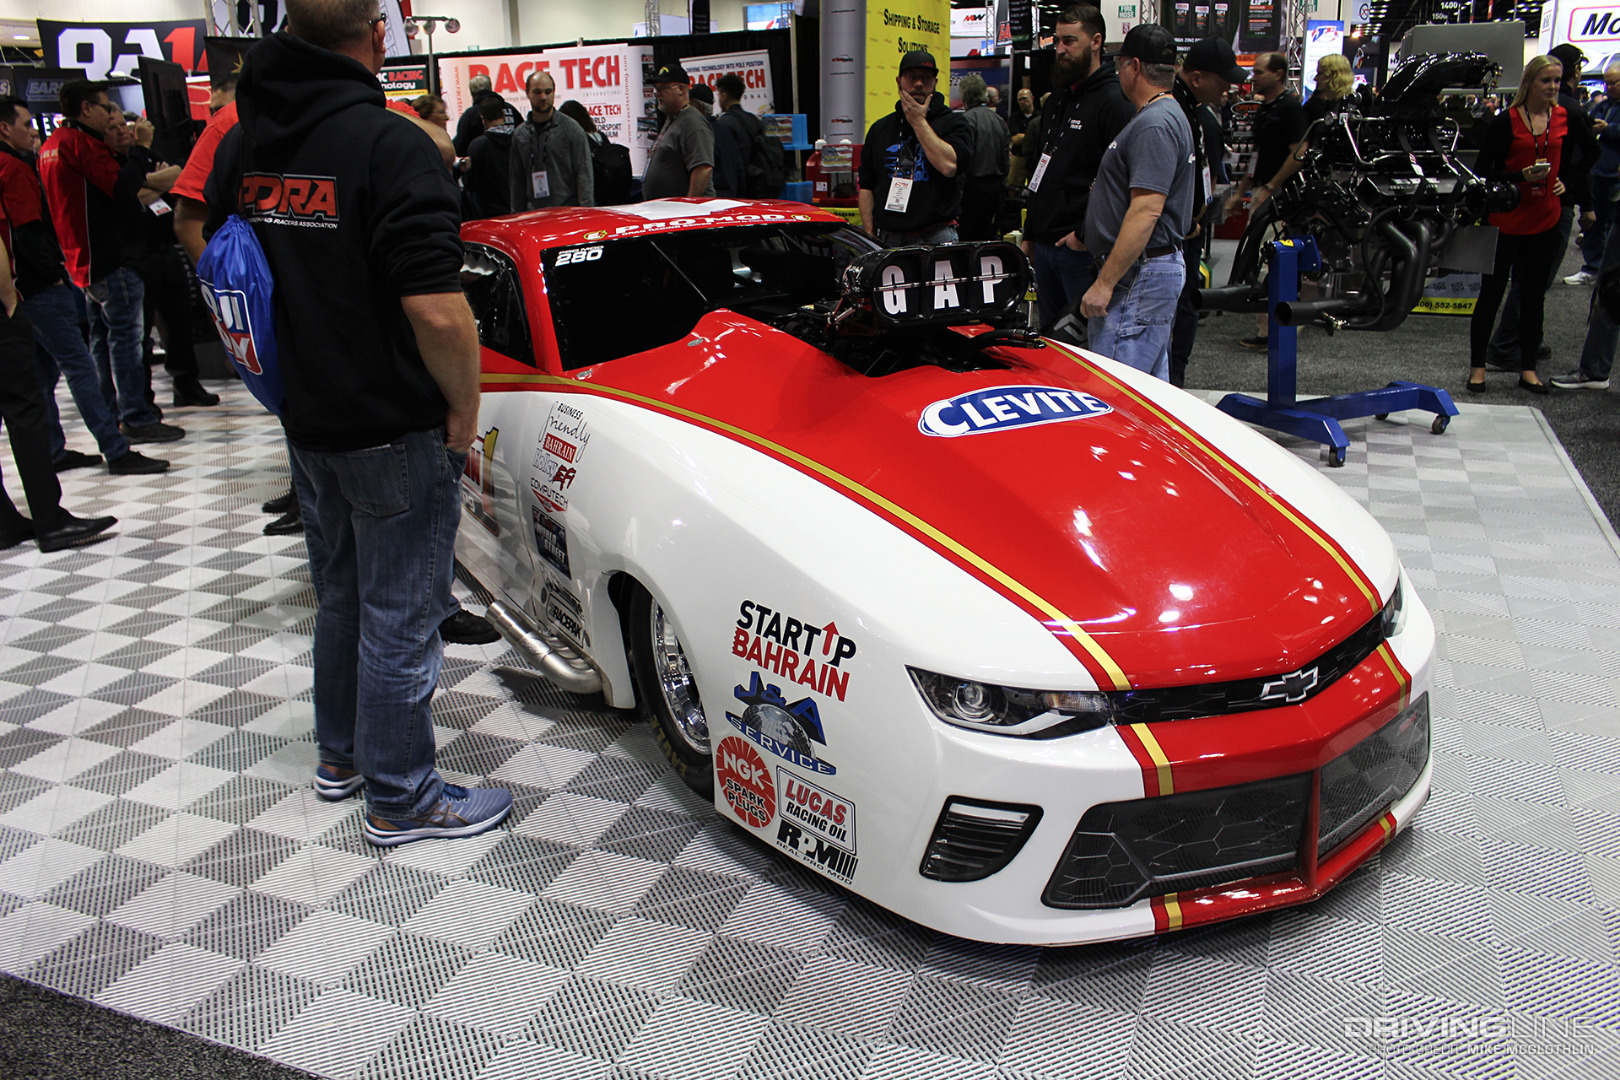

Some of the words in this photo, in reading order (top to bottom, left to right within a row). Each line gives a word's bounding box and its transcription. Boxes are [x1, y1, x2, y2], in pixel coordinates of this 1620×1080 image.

[912, 21, 916, 30] &
[58, 27, 208, 81] QA1
[701, 63, 725, 71] TECHNOLOGY
[381, 82, 416, 90] nology
[388, 70, 424, 81] RACING
[560, 55, 621, 90] TECH
[589, 106, 605, 117] ACE
[605, 105, 622, 115] TECH
[1236, 103, 1259, 111] DRIVE
[299, 220, 338, 229] ASSOCIATION
[615, 218, 697, 234] PRO
[704, 214, 786, 223] MOD
[555, 249, 603, 267] 280
[557, 402, 584, 420] BUSINESS
[924, 391, 1109, 437] CLEVITE
[538, 400, 591, 463] friendly
[544, 436, 576, 462] BAHRAIN
[530, 477, 569, 509] COMPUTECH
[544, 539, 566, 563] STREET
[731, 626, 850, 703] BAHRAIN
[733, 671, 827, 746] J&A
[729, 716, 832, 775] SERVICE
[723, 746, 765, 790] NGK
[726, 778, 765, 809] SPARK
[728, 791, 767, 823] PLUGS
[785, 779, 847, 825] LUCAS
[786, 802, 828, 833] RACING
[829, 823, 848, 843] OIL
[776, 839, 801, 857] REAL
[802, 856, 825, 872] PRO
[826, 867, 853, 885] MOD
